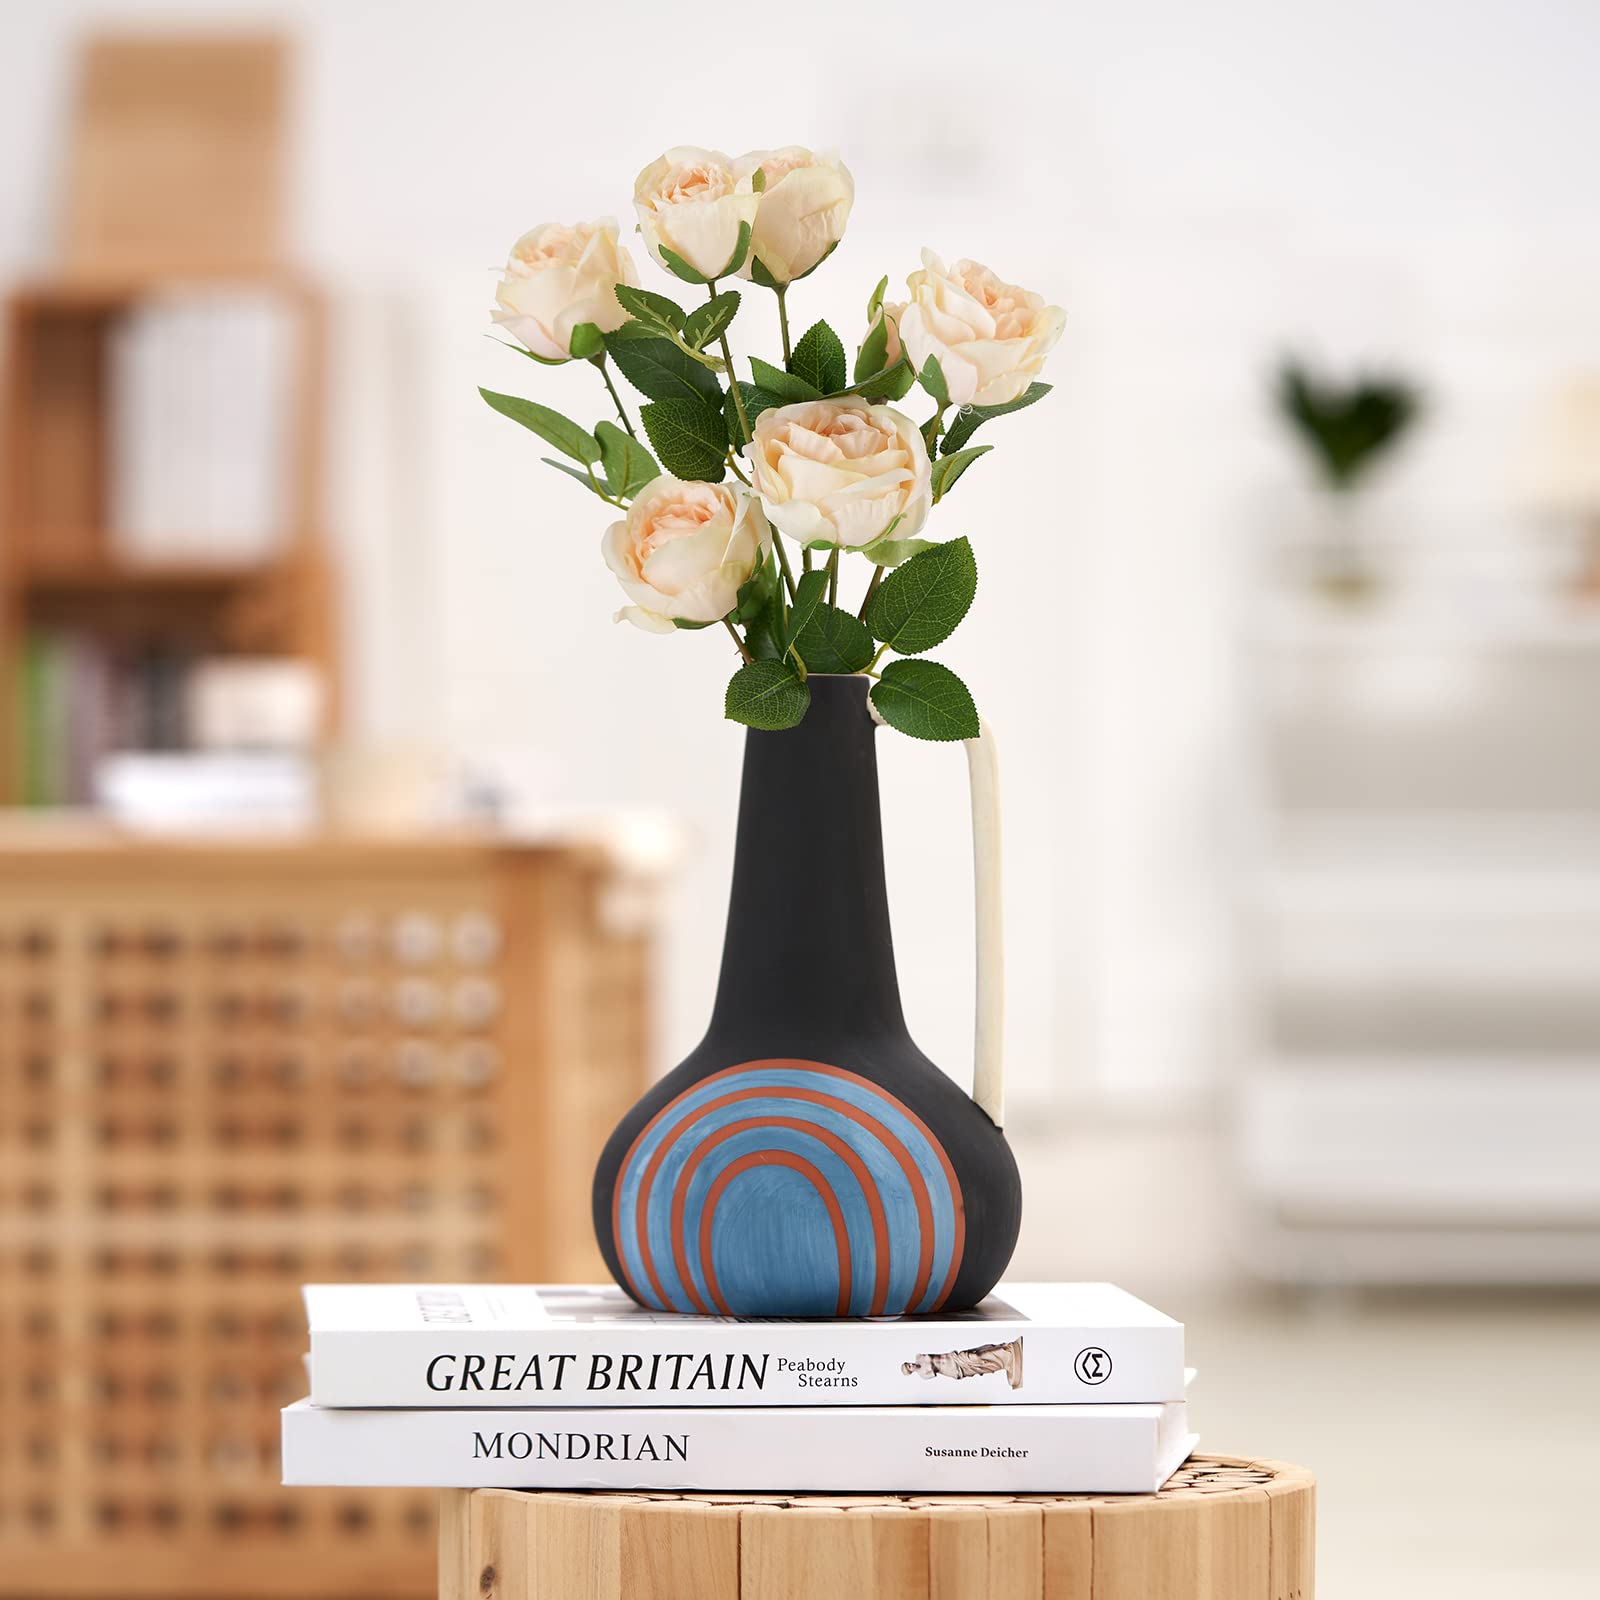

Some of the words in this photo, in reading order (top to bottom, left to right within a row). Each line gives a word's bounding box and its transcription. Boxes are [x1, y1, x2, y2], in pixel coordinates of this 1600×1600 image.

[425, 1354, 577, 1392] GREAT
[585, 1353, 771, 1391] BRITAIN
[777, 1357, 846, 1375] Peabody
[798, 1373, 858, 1388] Stearns
[472, 1431, 690, 1462] MONDRIAN
[925, 1446, 978, 1458] Susanne
[980, 1446, 1029, 1458] Deicher
